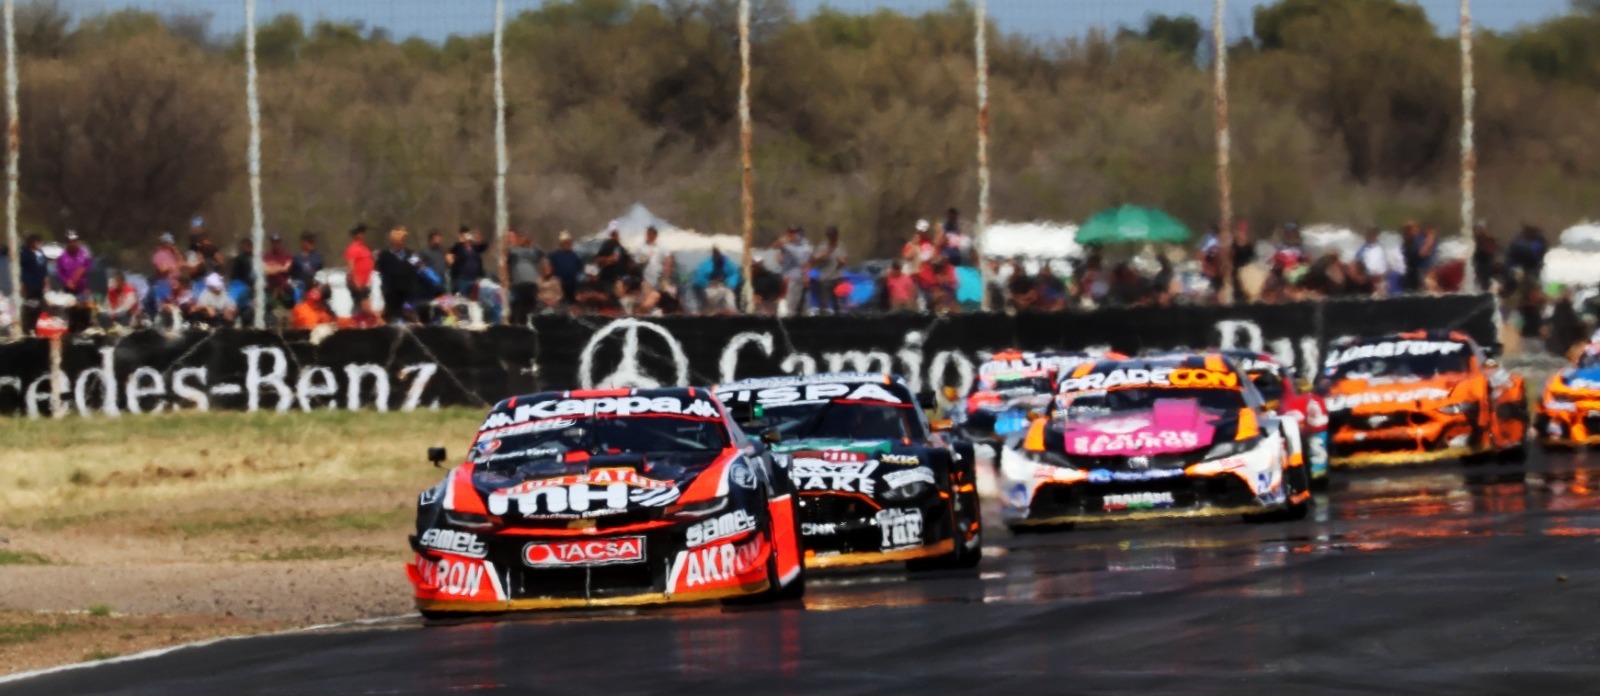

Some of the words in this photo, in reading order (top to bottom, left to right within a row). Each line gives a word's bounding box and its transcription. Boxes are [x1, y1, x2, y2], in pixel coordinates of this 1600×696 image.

[1060, 367, 1239, 393] PRADECON
[513, 398, 683, 422] Kappa
[557, 541, 637, 561] TACSA
